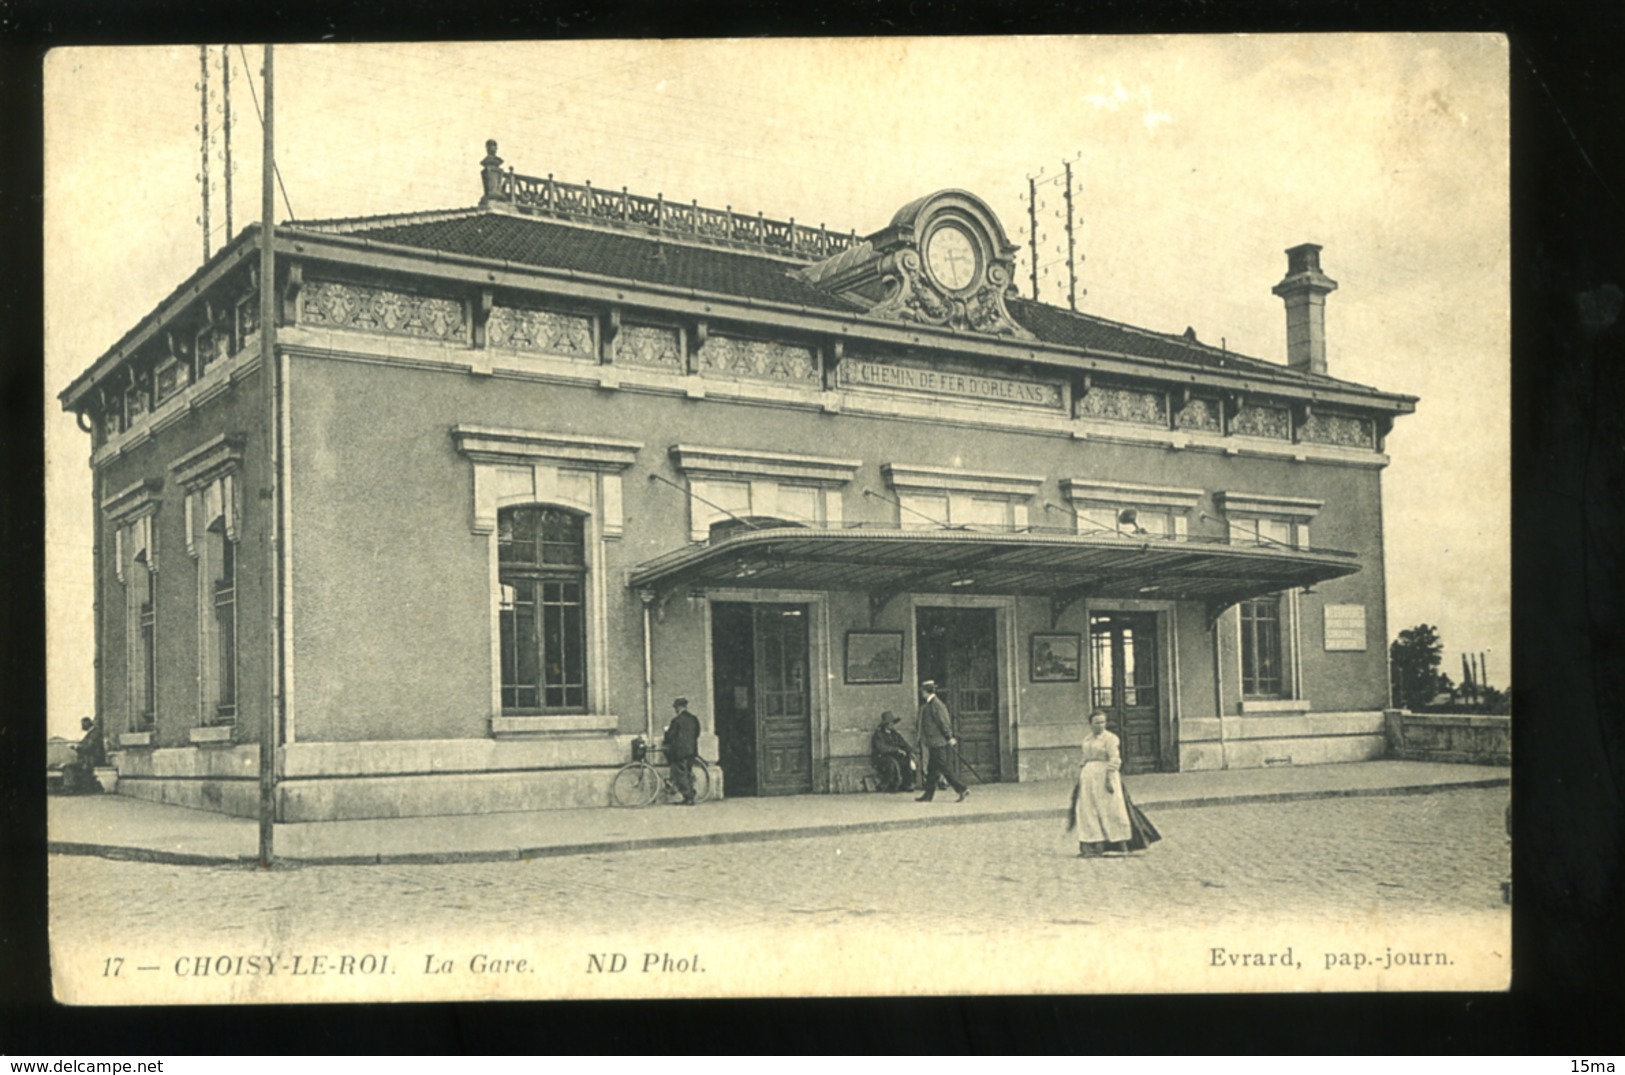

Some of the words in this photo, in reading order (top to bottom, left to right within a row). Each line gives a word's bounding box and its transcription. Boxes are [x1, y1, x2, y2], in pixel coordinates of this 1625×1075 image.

[861, 364, 915, 387] CHEMIN
[919, 371, 936, 389] DE
[940, 374, 966, 393] FER
[102, 957, 124, 977] 17
[174, 954, 396, 977] CHOISY-LE-ROI.
[424, 954, 453, 974] La
[469, 954, 534, 974] Gare.
[586, 953, 627, 973] ND
[642, 953, 707, 973] Phot.
[1210, 947, 1302, 969] Evrard,
[1325, 948, 1455, 969] pap.-journ.
